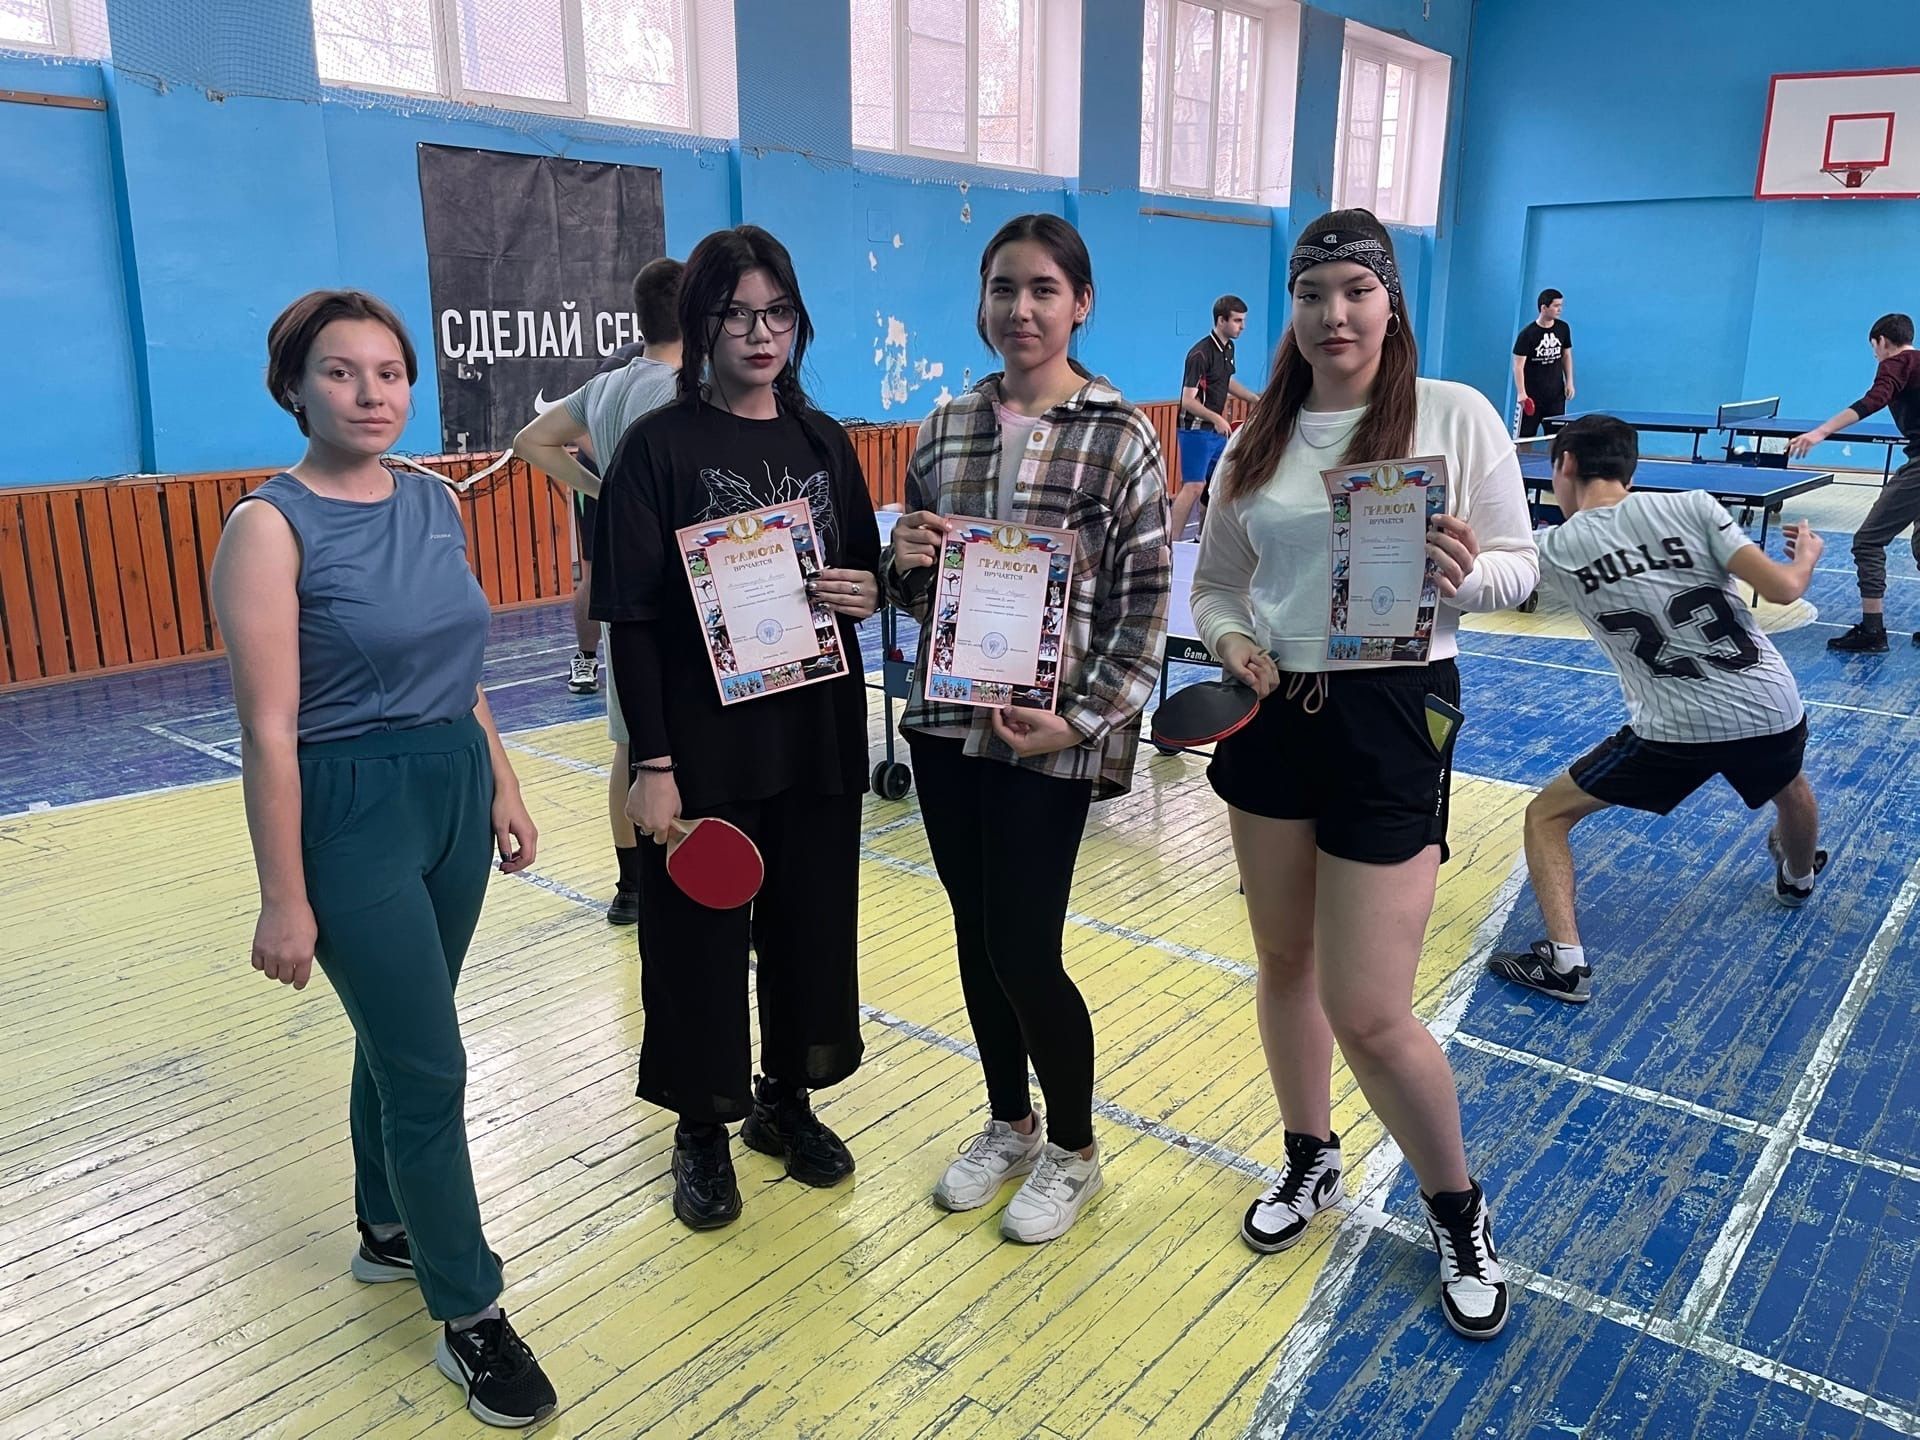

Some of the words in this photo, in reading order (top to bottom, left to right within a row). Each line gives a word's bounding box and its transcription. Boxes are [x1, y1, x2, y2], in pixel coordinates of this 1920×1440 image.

[441, 301, 583, 365] СДЕЛАЙ
[1364, 503, 1416, 517] ГРАМОТА
[724, 543, 784, 566] ГРАМОТА
[733, 558, 773, 572] ВРУЧАЕТСЯ
[977, 558, 1038, 574] ГРАМОТА
[1575, 537, 1694, 595] BULLS
[984, 570, 1023, 581] ВРУЧАЕТСЯ
[1594, 582, 1763, 682] 23
[1184, 647, 1208, 660] Game
